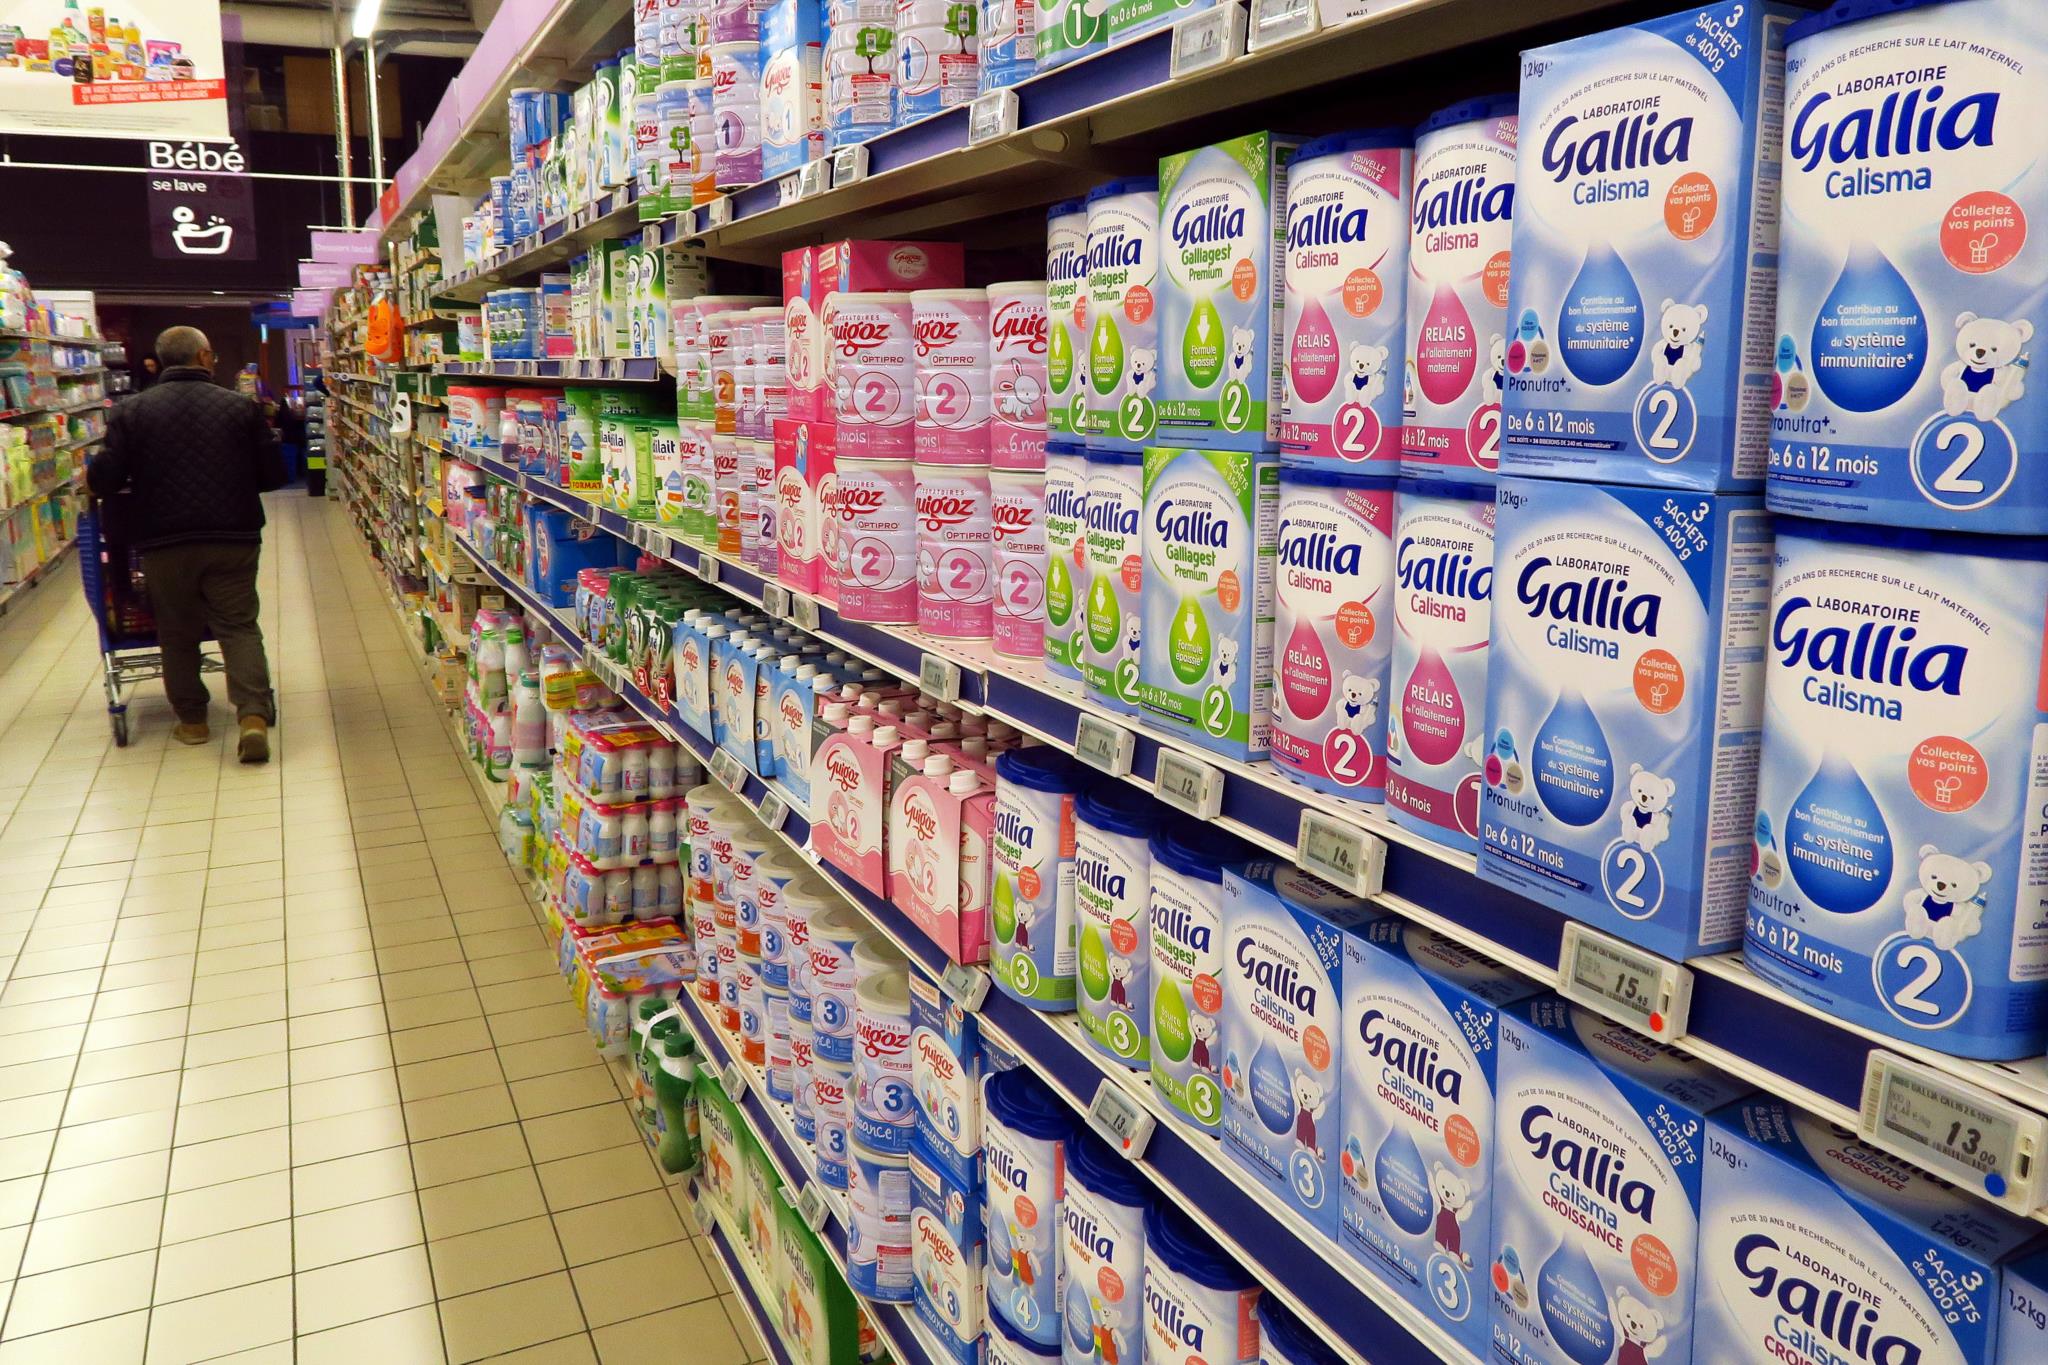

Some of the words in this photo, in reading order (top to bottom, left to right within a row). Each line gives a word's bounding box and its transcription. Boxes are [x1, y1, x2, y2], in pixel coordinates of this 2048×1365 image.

[1131, 4, 1137, 18] 6
[1802, 78, 1811, 89] DE
[1811, 71, 1820, 82] 30
[1820, 60, 1836, 76] ANS
[1836, 53, 1848, 65] DE
[1849, 38, 1902, 58] RECHERCHE
[1904, 38, 1925, 47] SUR
[1928, 38, 1941, 47] LE
[1943, 39, 1968, 51] LAIT
[1968, 43, 2024, 76] MATERNEL
[1836, 66, 1947, 96] LABORATOIRE
[1789, 85, 2000, 173] Gallia
[150, 141, 245, 172] Bébé
[1541, 112, 1694, 184] Gallia
[1350, 161, 1383, 183] FORMULE
[1352, 152, 1387, 174] NOUVELLE
[1432, 164, 1487, 182] LABORATOIRE
[152, 182, 170, 191] se
[174, 179, 207, 193] lave
[1572, 178, 1650, 206] Calisma
[1824, 165, 1932, 200] Calisma
[1413, 176, 1515, 235] Gallia
[1952, 203, 2012, 219] Collectez
[1172, 204, 1245, 249] Gallia
[1948, 217, 1971, 231] vos
[1973, 214, 2015, 229] points
[1181, 243, 1232, 266] Galliagest
[1426, 232, 1479, 253] Calisma
[1188, 264, 1223, 282] Premium
[1296, 251, 1339, 269] Calisma
[1821, 316, 1838, 327] bon
[1840, 316, 1917, 326] fonctionnement
[1837, 305, 1881, 316] Contribue
[1885, 305, 1898, 314] au
[1297, 334, 1330, 348] RELAIS
[1426, 326, 1466, 342] RELAIS
[1831, 337, 1842, 348] du
[1844, 332, 1906, 348] système
[861, 356, 904, 364] OPTIPRO
[932, 356, 975, 364] OPTIPRO
[865, 381, 886, 412] 2
[936, 382, 956, 414] 2
[1508, 415, 1522, 430] De
[1525, 413, 1533, 430] 6
[1537, 416, 1544, 432] à
[1548, 412, 1564, 433] 12
[1567, 420, 1595, 434] mois
[1649, 389, 1679, 449] 2
[1783, 445, 1790, 466] 6
[1796, 452, 1805, 468] à
[1810, 447, 1830, 471] 12
[1835, 457, 1879, 475] mois
[1934, 422, 1985, 493] 2
[778, 474, 802, 508] Guigoz
[1346, 490, 1380, 513] NOUVELLE
[1343, 497, 1376, 521] FORMULE
[761, 513, 771, 538] 2
[858, 521, 898, 530] OPTIPRO
[946, 532, 990, 540] OPTIPRO
[1156, 500, 1228, 548] Gallia
[1662, 499, 1708, 552] SACHETS
[861, 547, 880, 576] 2
[1090, 549, 1117, 565] Premium
[1166, 544, 1216, 567] Galliagest
[1556, 556, 1630, 577] LABORATOIRE
[950, 558, 972, 589] 2
[1174, 564, 1208, 583] Premium
[1411, 594, 1466, 623] Calisma
[1517, 556, 1662, 637] Gallia
[1816, 596, 1920, 623] LABORATOIRE
[1547, 624, 1619, 660] Calisma
[1773, 597, 1968, 696] Gallia
[1288, 650, 1322, 670] RELAIS
[1640, 656, 1677, 672] Collectez
[659, 682, 666, 698] 3
[1638, 668, 1652, 677] vos
[1653, 671, 1679, 683] points
[1208, 691, 1224, 730] 2
[1411, 684, 1454, 709] RELAIS
[1803, 676, 1902, 721] Calisma
[1413, 721, 1448, 738] maternel
[1916, 757, 1936, 768] vos
[1938, 760, 1978, 775] points
[1920, 745, 1974, 762] Collectez
[826, 750, 860, 792] Guigoz
[1557, 761, 1600, 783] système
[850, 819, 858, 841] 2
[904, 794, 937, 841] Guigoz
[1485, 824, 1498, 841] De
[1500, 827, 1508, 845] 6
[1510, 833, 1519, 850] à
[1521, 834, 1535, 857] 12
[1538, 846, 1564, 869] mois
[1816, 834, 1874, 861] système
[698, 854, 707, 873] 3
[740, 902, 750, 922] 3
[765, 930, 776, 952] 3
[1152, 927, 1197, 966] Galliagest
[1257, 940, 1300, 970] LABORATOIRE
[1315, 924, 1340, 968] SACHETS
[1154, 948, 1193, 979] CROISSANCE
[1236, 937, 1317, 1018] Gallia
[726, 983, 736, 1002] 3
[1616, 973, 1640, 999] 15
[1894, 945, 1942, 1016] 2
[824, 999, 839, 1025] 3
[1254, 988, 1295, 1026] Calisma
[1250, 1003, 1299, 1042] CROISSANCE
[1387, 1014, 1440, 1050] LABORATOIRE
[1460, 1000, 1492, 1051] SACHETS
[918, 1033, 954, 1080] Guigoz
[1360, 1009, 1462, 1105] Gallia
[883, 1084, 904, 1112] 3
[1382, 1068, 1434, 1114] Calisma
[1112, 1114, 1125, 1130] 13
[1377, 1085, 1438, 1133] CROISSANCE
[830, 1129, 845, 1153] 3
[1557, 1112, 1627, 1160] LABORATOIRE
[1655, 1104, 1696, 1165] SACHETS
[1946, 1121, 1981, 1155] 13
[1979, 1151, 1997, 1166] 00
[1520, 1105, 1656, 1224] Gallia
[1826, 1148, 1906, 1192] CROISSANCE
[991, 1172, 1008, 1194] Junior
[1550, 1172, 1617, 1230] Calisma
[1542, 1190, 1624, 1253] CROISSANCE
[918, 1215, 955, 1266] Guigoz
[1069, 1236, 1092, 1265] Junior
[1437, 1262, 1458, 1310] 3
[1785, 1245, 1882, 1309] LABORATOIRE
[1924, 1248, 1981, 1324] SACHETS
[1961, 1271, 1984, 1292] 3
[1016, 1296, 1032, 1324] 4
[1152, 1318, 1178, 1352] Junior
